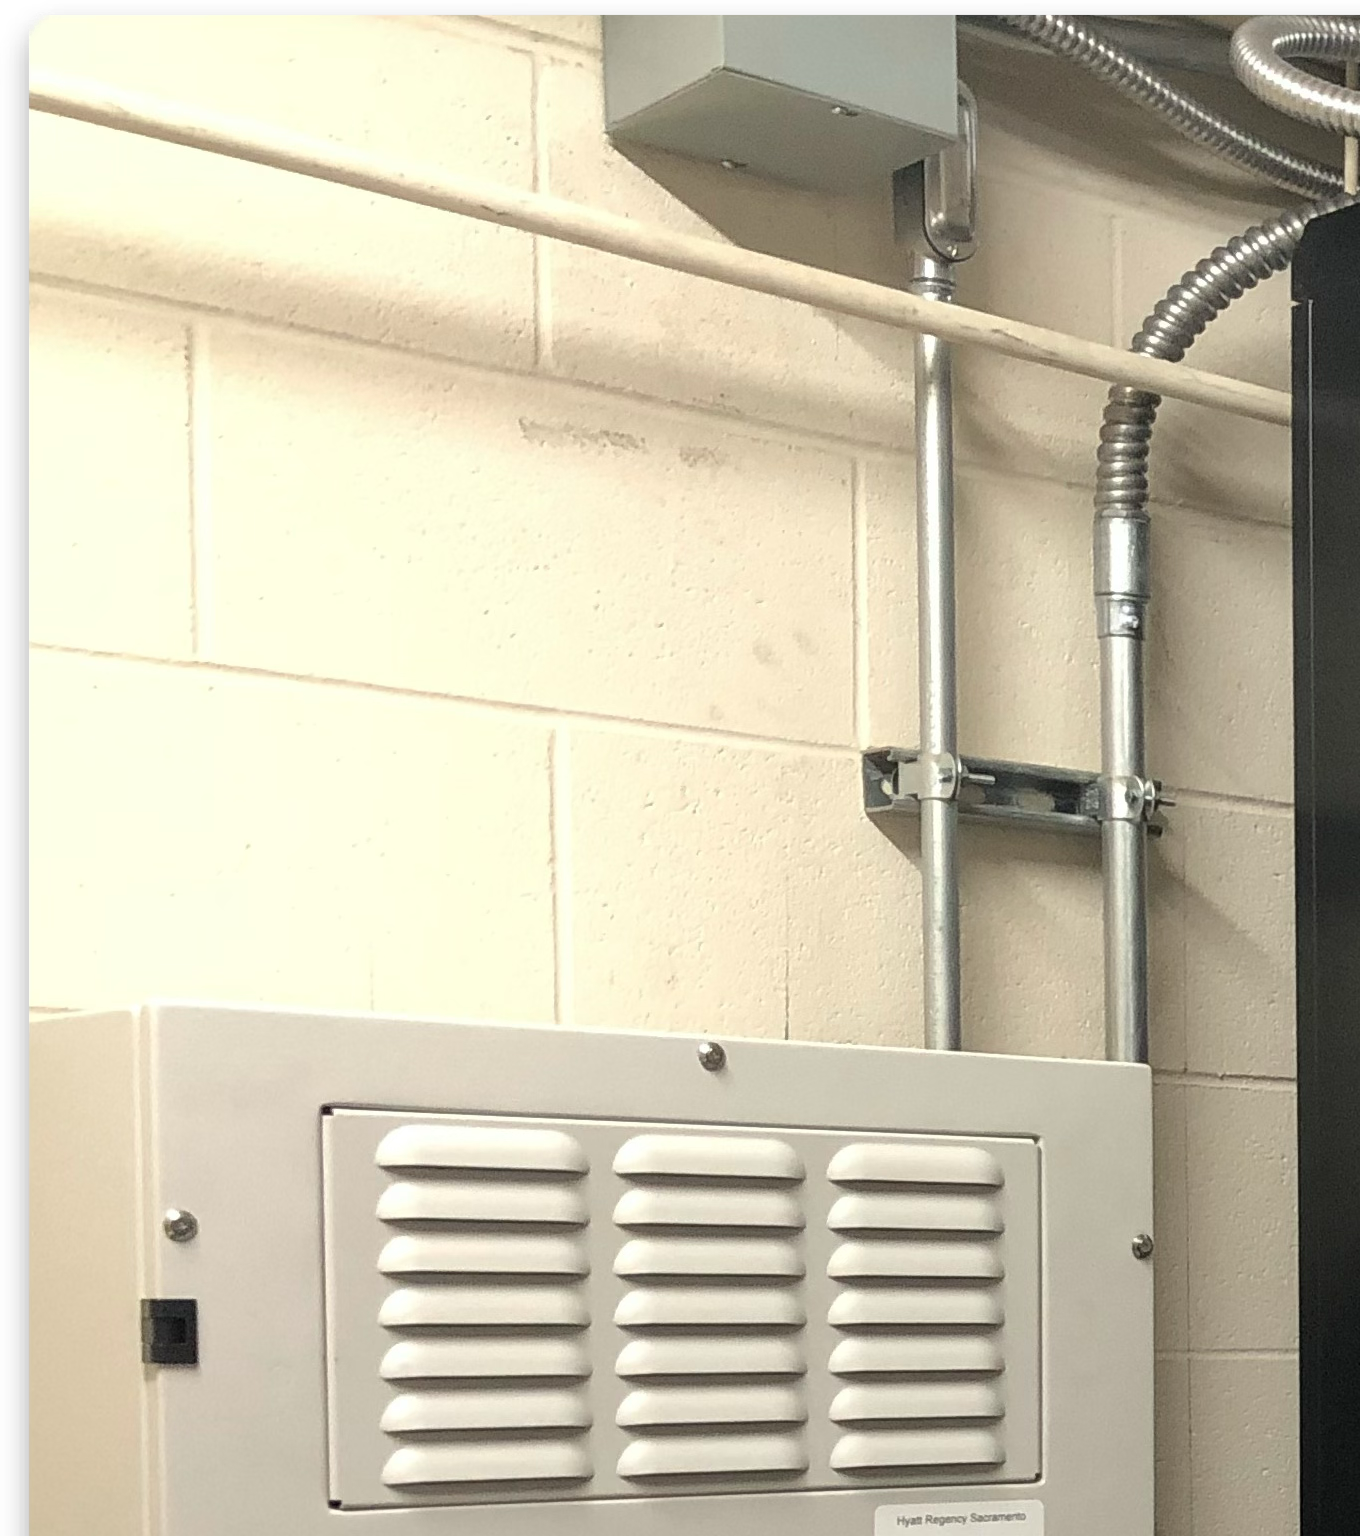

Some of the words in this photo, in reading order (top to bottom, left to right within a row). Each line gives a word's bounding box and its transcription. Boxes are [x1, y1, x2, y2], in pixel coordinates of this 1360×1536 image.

[896, 1515, 923, 1528] Hyatt
[925, 1514, 968, 1527] Regency
[970, 1512, 1027, 1523] Sacramento
